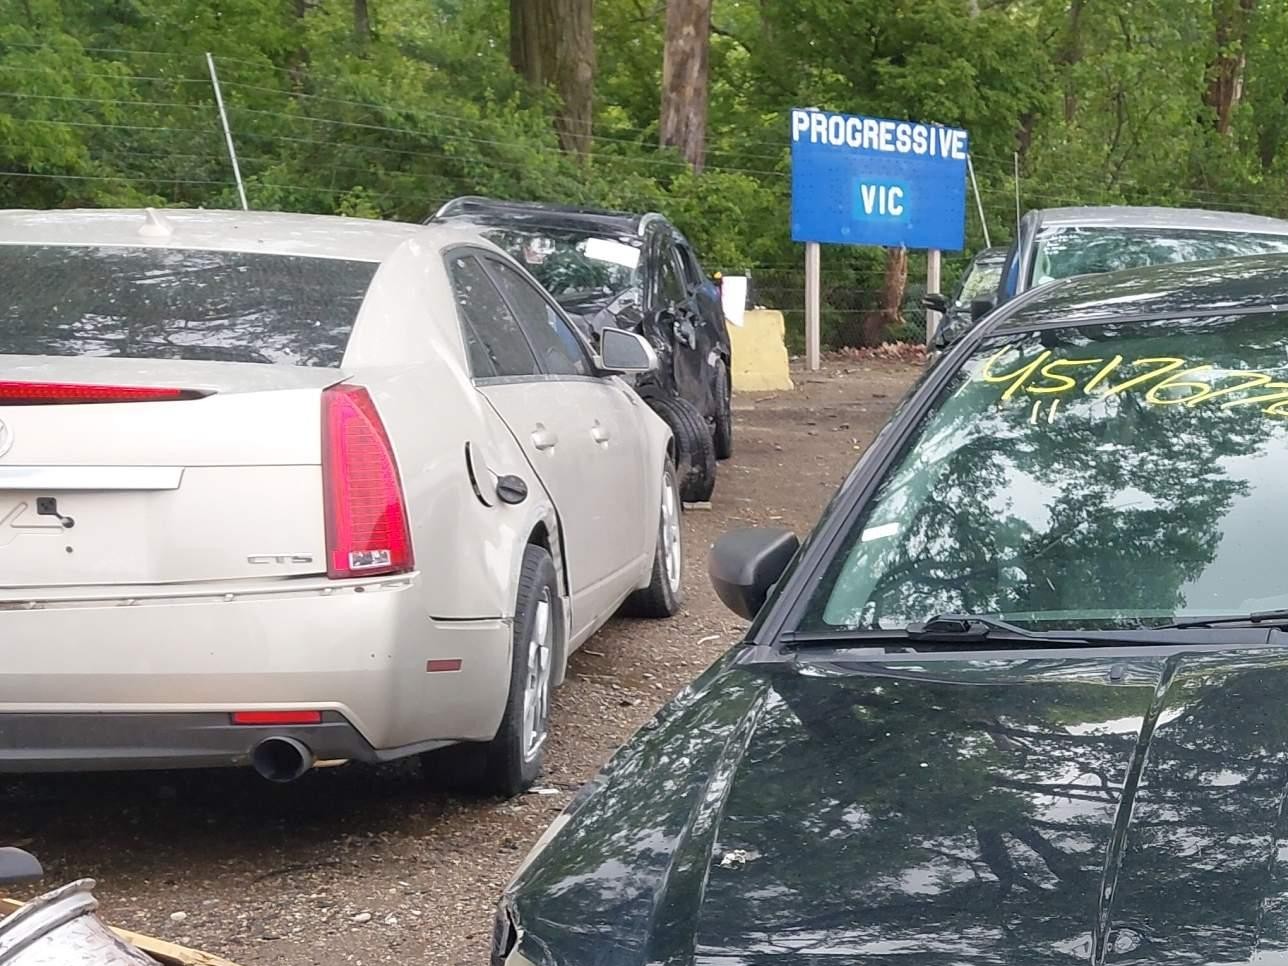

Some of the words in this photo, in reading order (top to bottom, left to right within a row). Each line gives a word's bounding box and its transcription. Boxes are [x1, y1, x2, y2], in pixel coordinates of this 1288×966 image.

[791, 110, 967, 159] PROGRESSIVE
[860, 184, 904, 216] VIC
[247, 553, 313, 565] CTS
